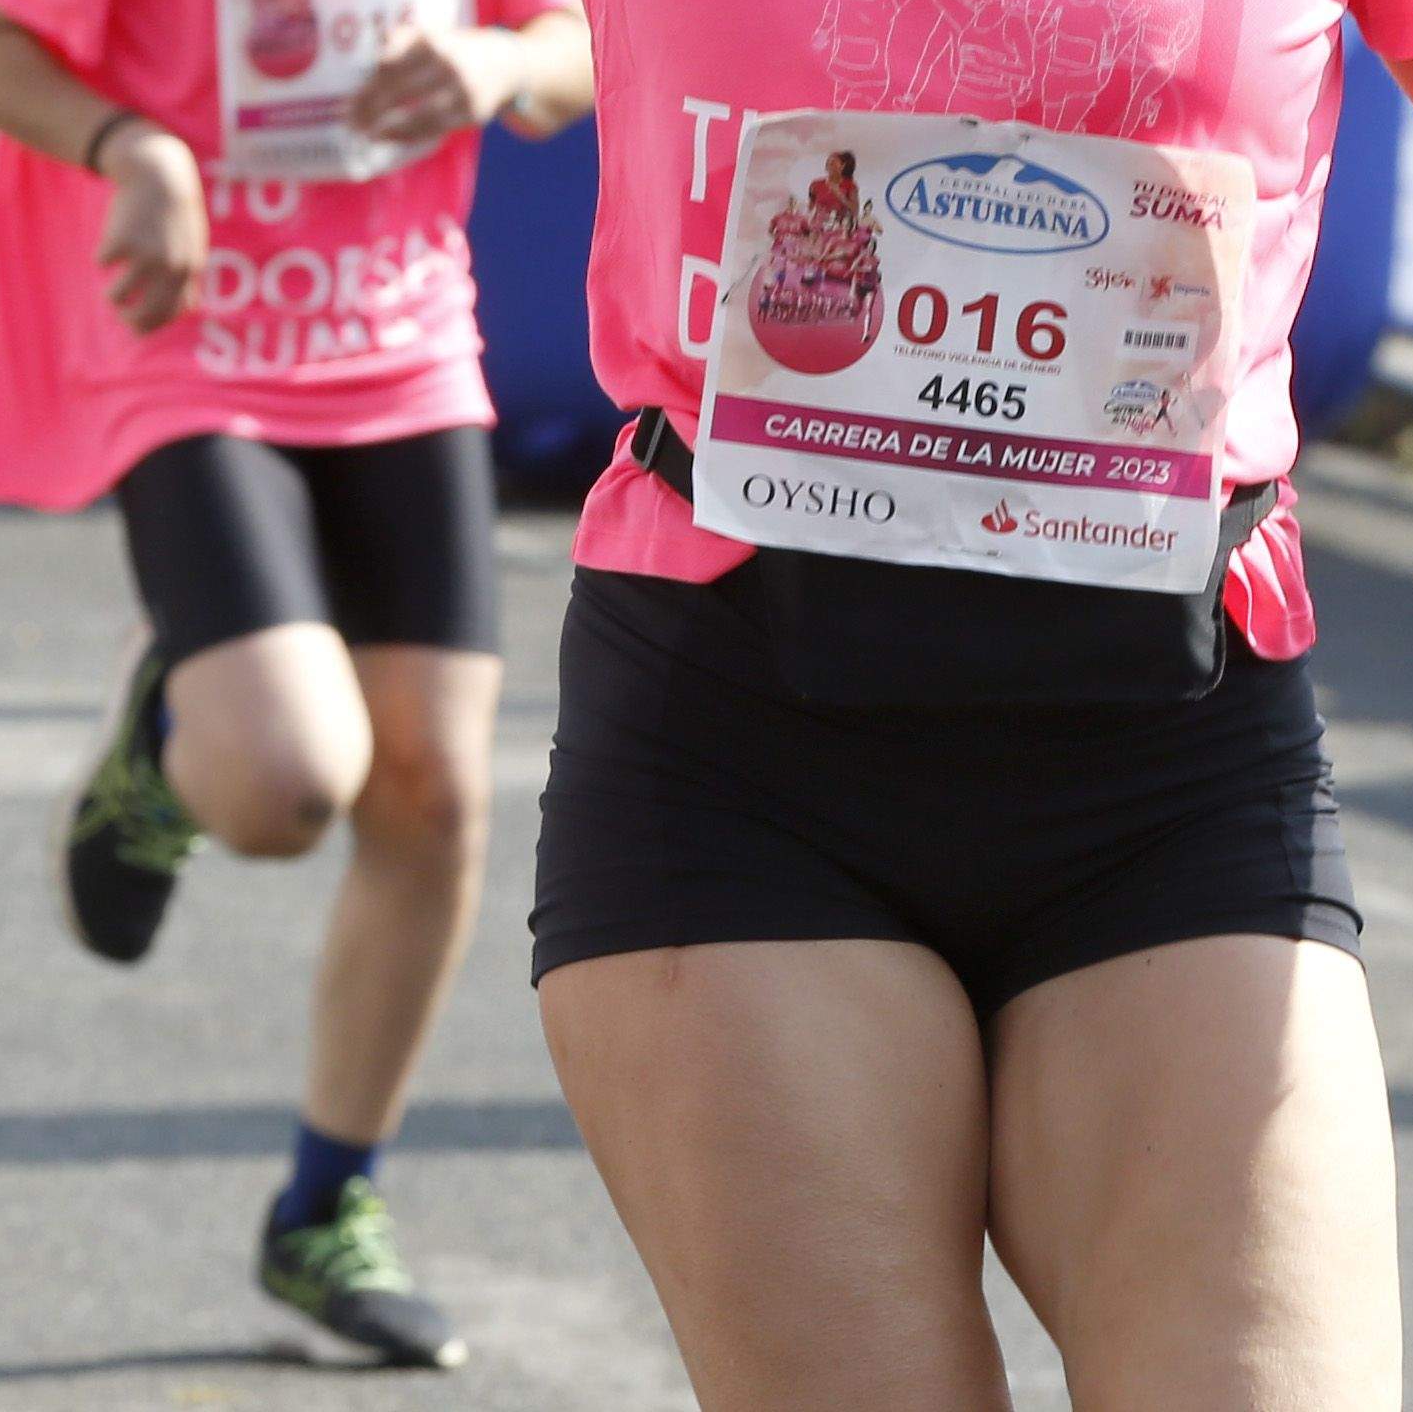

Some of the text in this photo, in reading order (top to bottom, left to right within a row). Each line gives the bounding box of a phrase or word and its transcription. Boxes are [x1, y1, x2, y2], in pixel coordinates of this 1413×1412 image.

[902, 175, 1090, 239] ASTURIANA
[940, 177, 1087, 210] CENTRAL LECHERA
[1129, 193, 1223, 230] SUMA
[897, 283, 1069, 362] 016
[917, 371, 1028, 421] 4465
[763, 413, 1173, 486] CARRERA DE LA MUJER 2023
[741, 472, 897, 525] OYSHO
[1023, 510, 1179, 553] Santander
